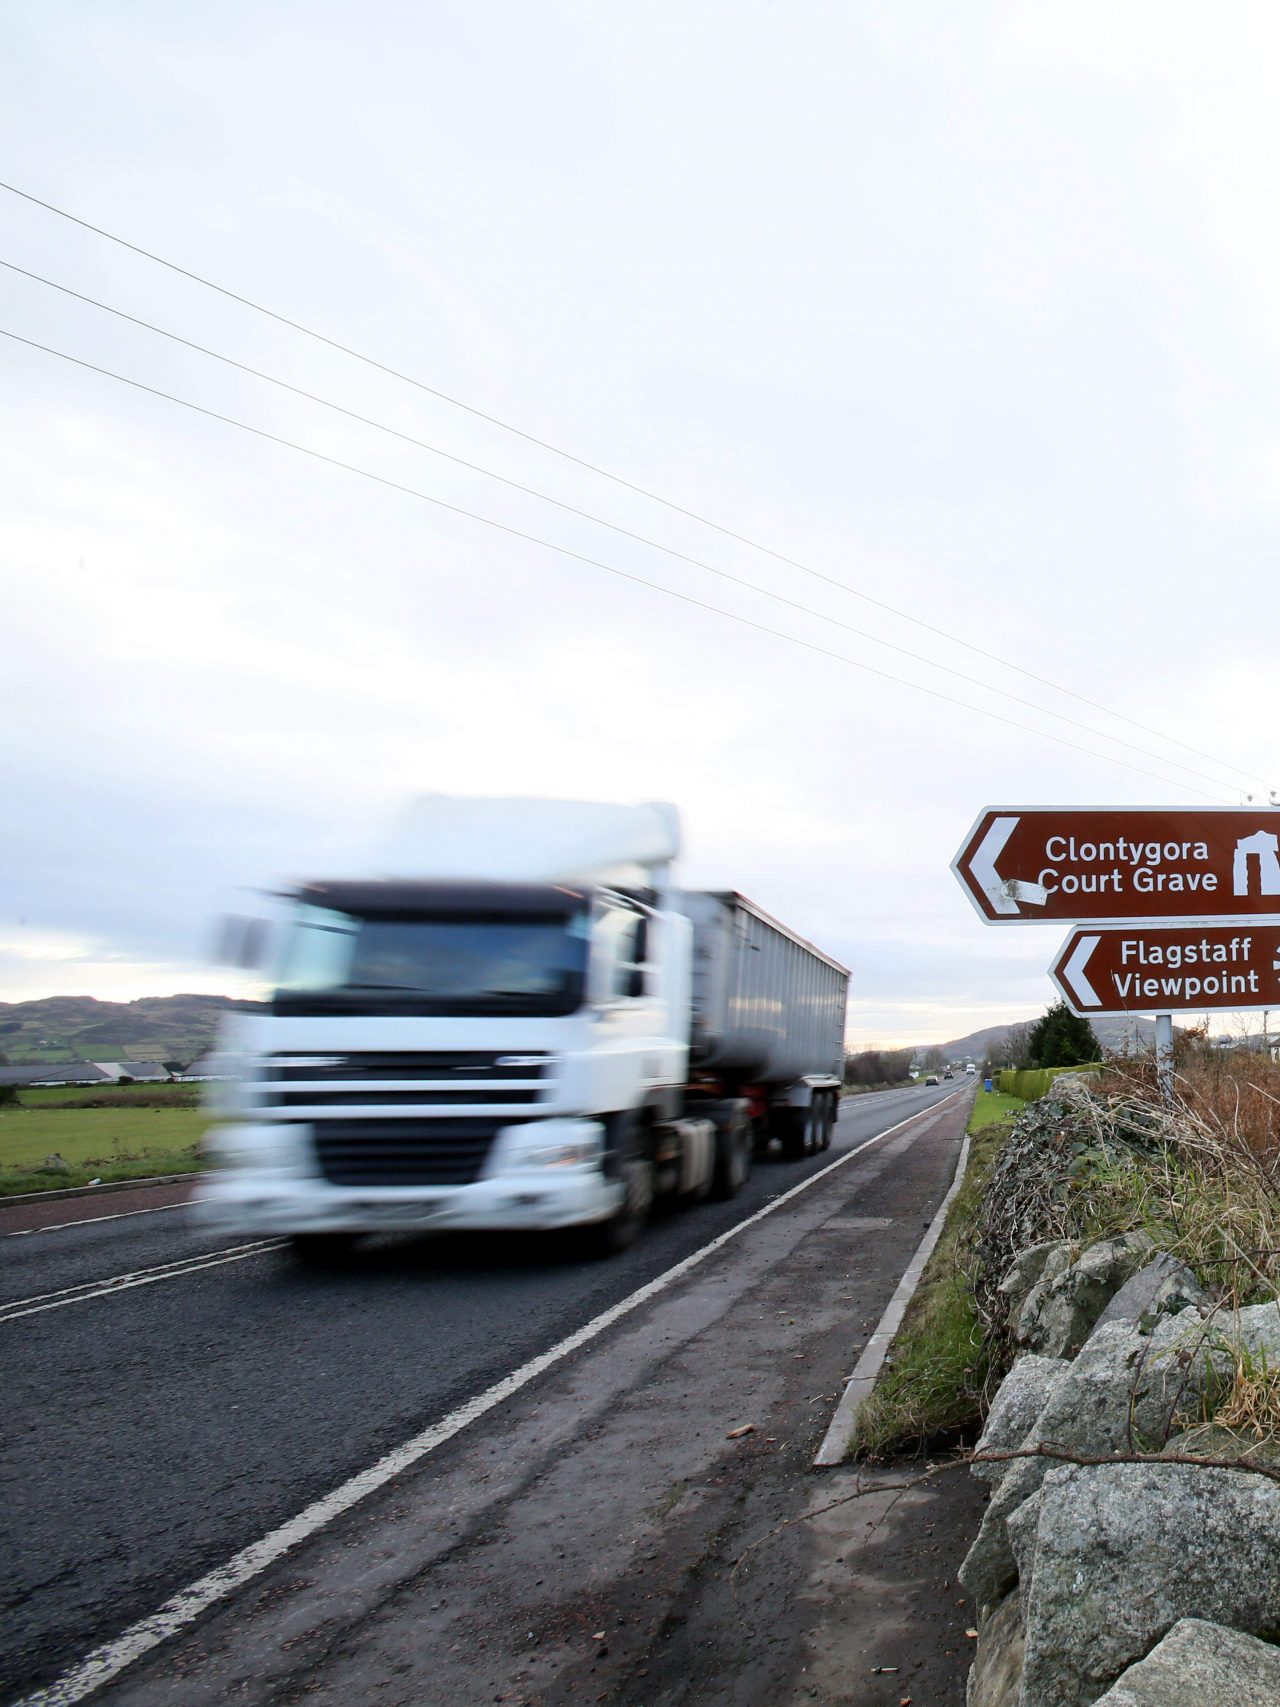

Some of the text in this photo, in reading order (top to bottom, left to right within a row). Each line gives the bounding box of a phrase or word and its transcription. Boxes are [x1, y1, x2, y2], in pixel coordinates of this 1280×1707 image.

[1045, 836, 1209, 867] Clontygora
[1037, 868, 1218, 895] Court Grave
[1120, 937, 1252, 968] Flagstaff
[1113, 970, 1259, 1000] Viewpoint
